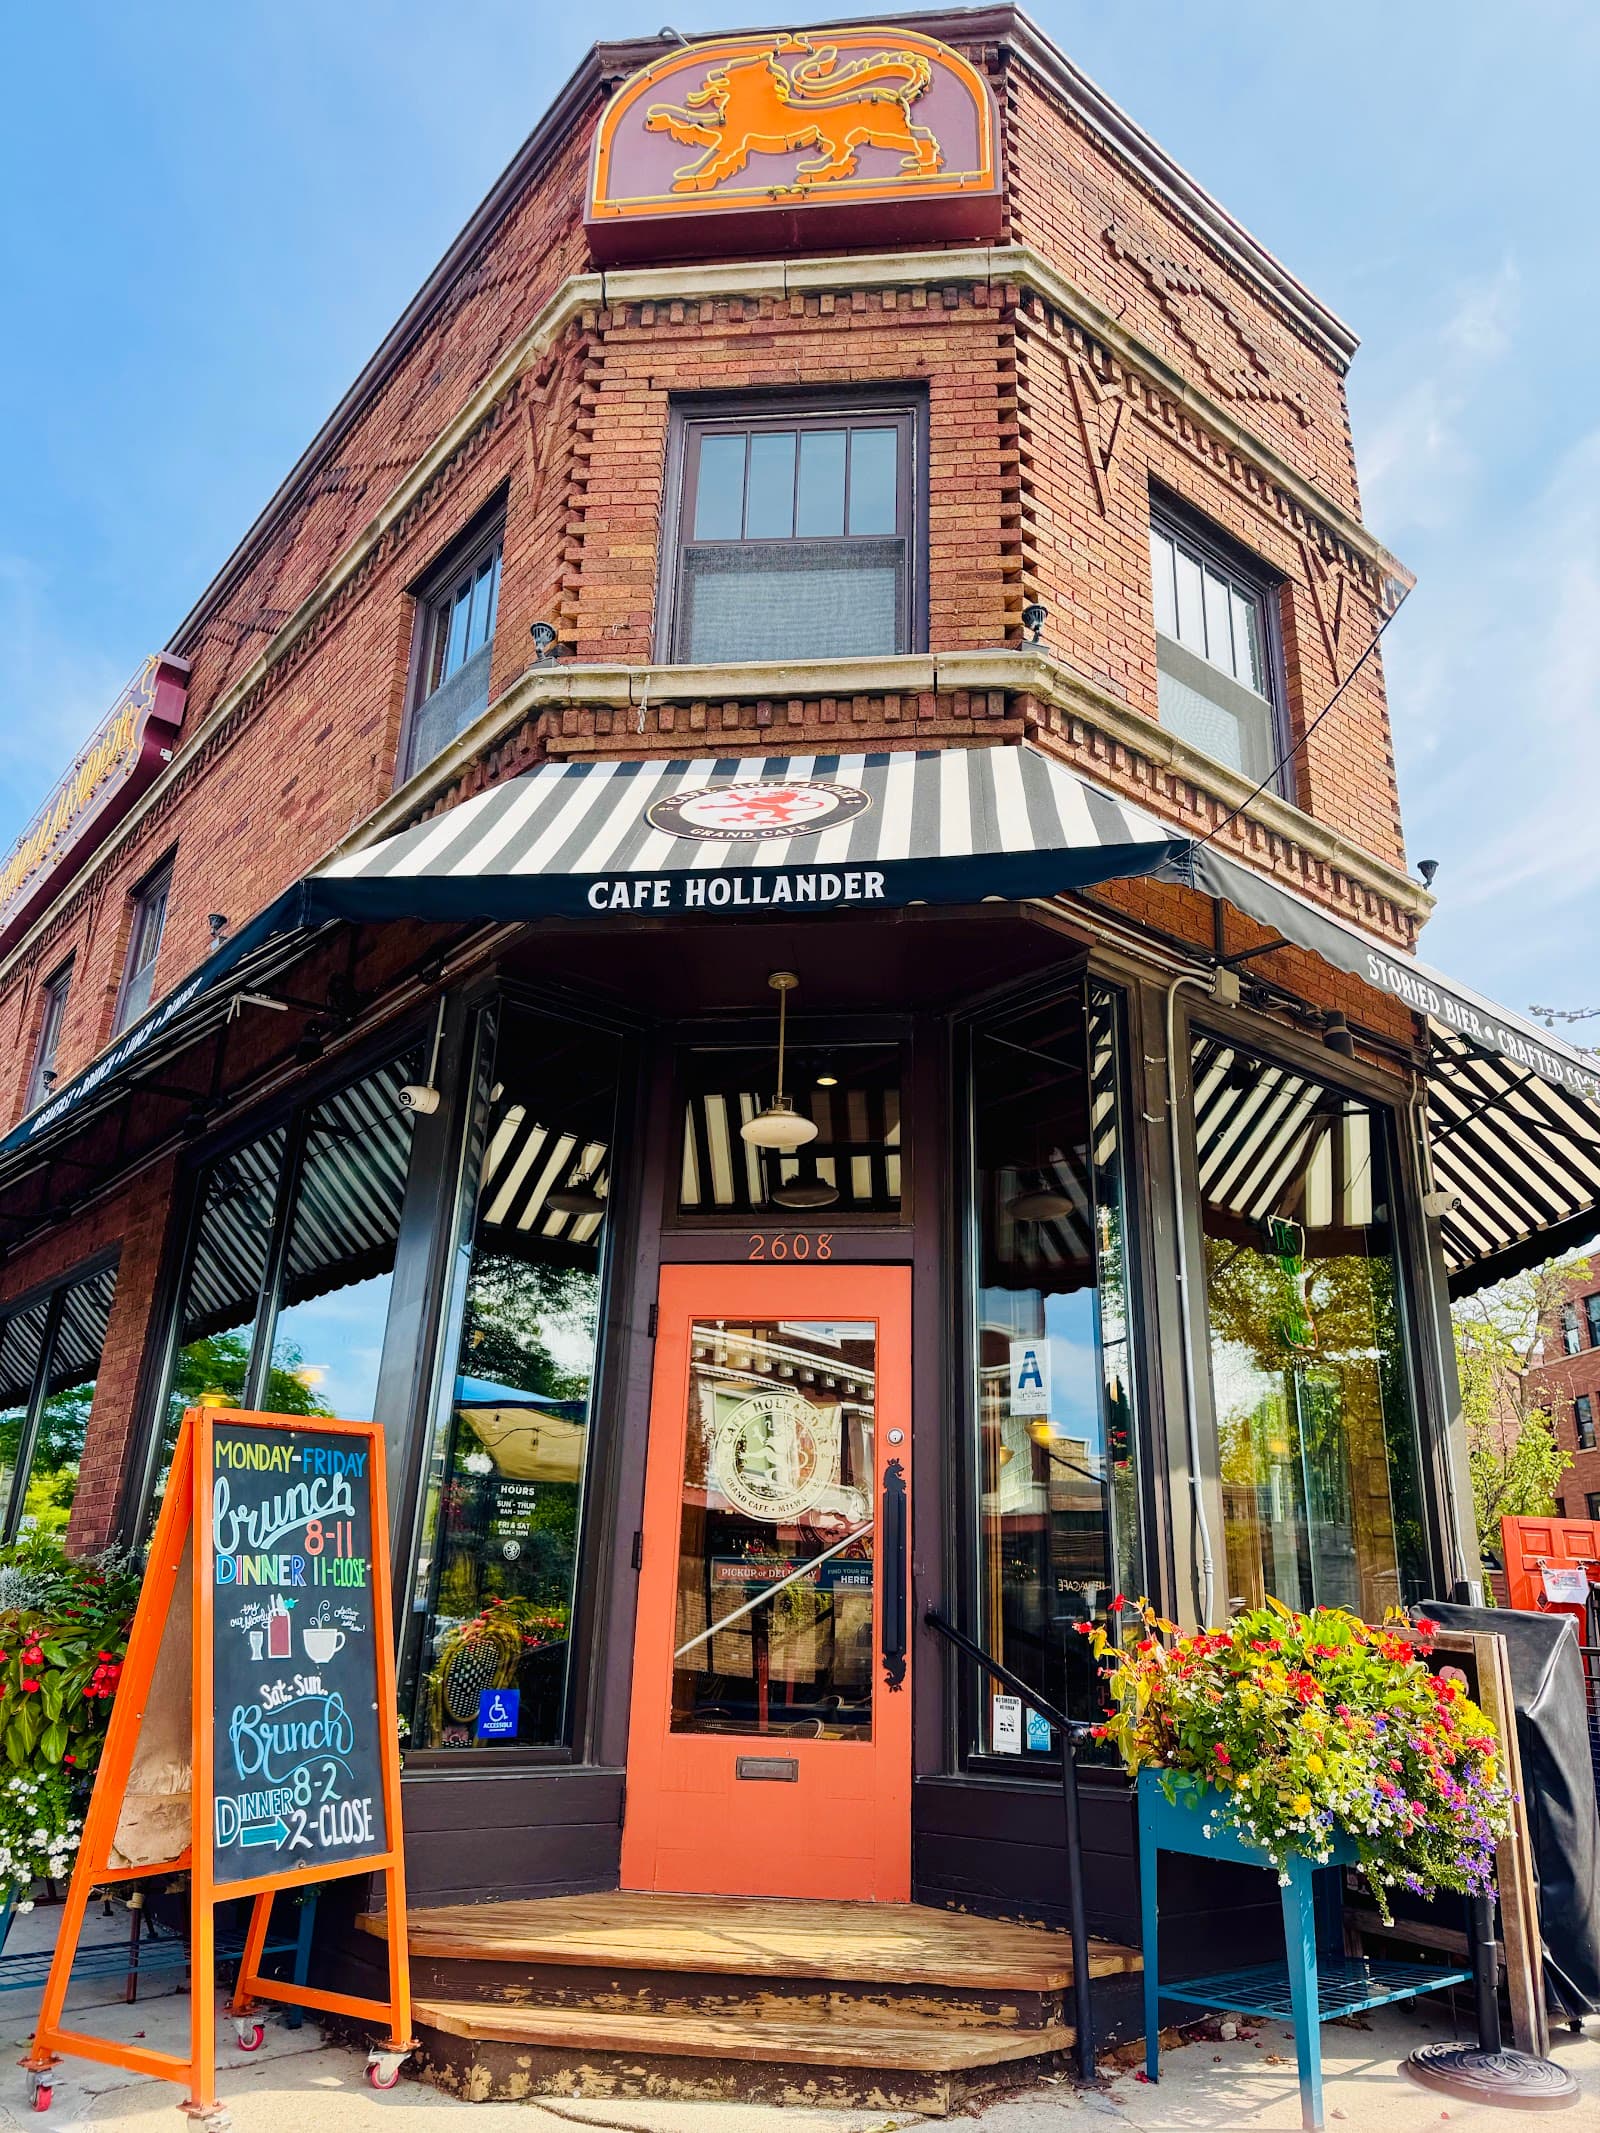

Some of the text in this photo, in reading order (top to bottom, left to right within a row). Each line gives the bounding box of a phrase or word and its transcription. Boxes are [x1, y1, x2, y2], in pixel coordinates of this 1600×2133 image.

[666, 781, 860, 805] CAFE HOLLANDER
[690, 824, 811, 839] GRAND CAFE
[587, 871, 886, 910] CAFE HOLLANDER
[1367, 953, 1440, 1015] STORIED
[1443, 997, 1484, 1039] BIER
[1497, 1029, 1563, 1081] CRAFTED
[748, 1233, 833, 1260] 2608
[1018, 1350, 1043, 1389] A
[723, 1411, 749, 1444] CAFE
[496, 1500, 511, 1508] SUN
[517, 1502, 536, 1510] THUR
[500, 1485, 535, 1496] HOURS
[726, 1477, 769, 1512] GRAND CAFE
[213, 1471, 356, 1555] brunch
[516, 1522, 531, 1530] SAT
[304, 1520, 352, 1557] 8-11
[216, 1554, 307, 1587] DINNER
[722, 1568, 757, 1577] PICKUP
[840, 1575, 869, 1584] HERE!
[229, 1692, 354, 1783] Brunch
[294, 1762, 342, 1806] 8-2
[215, 1788, 295, 1848] DINNER
[289, 1798, 375, 1850] 2-CLOSE
